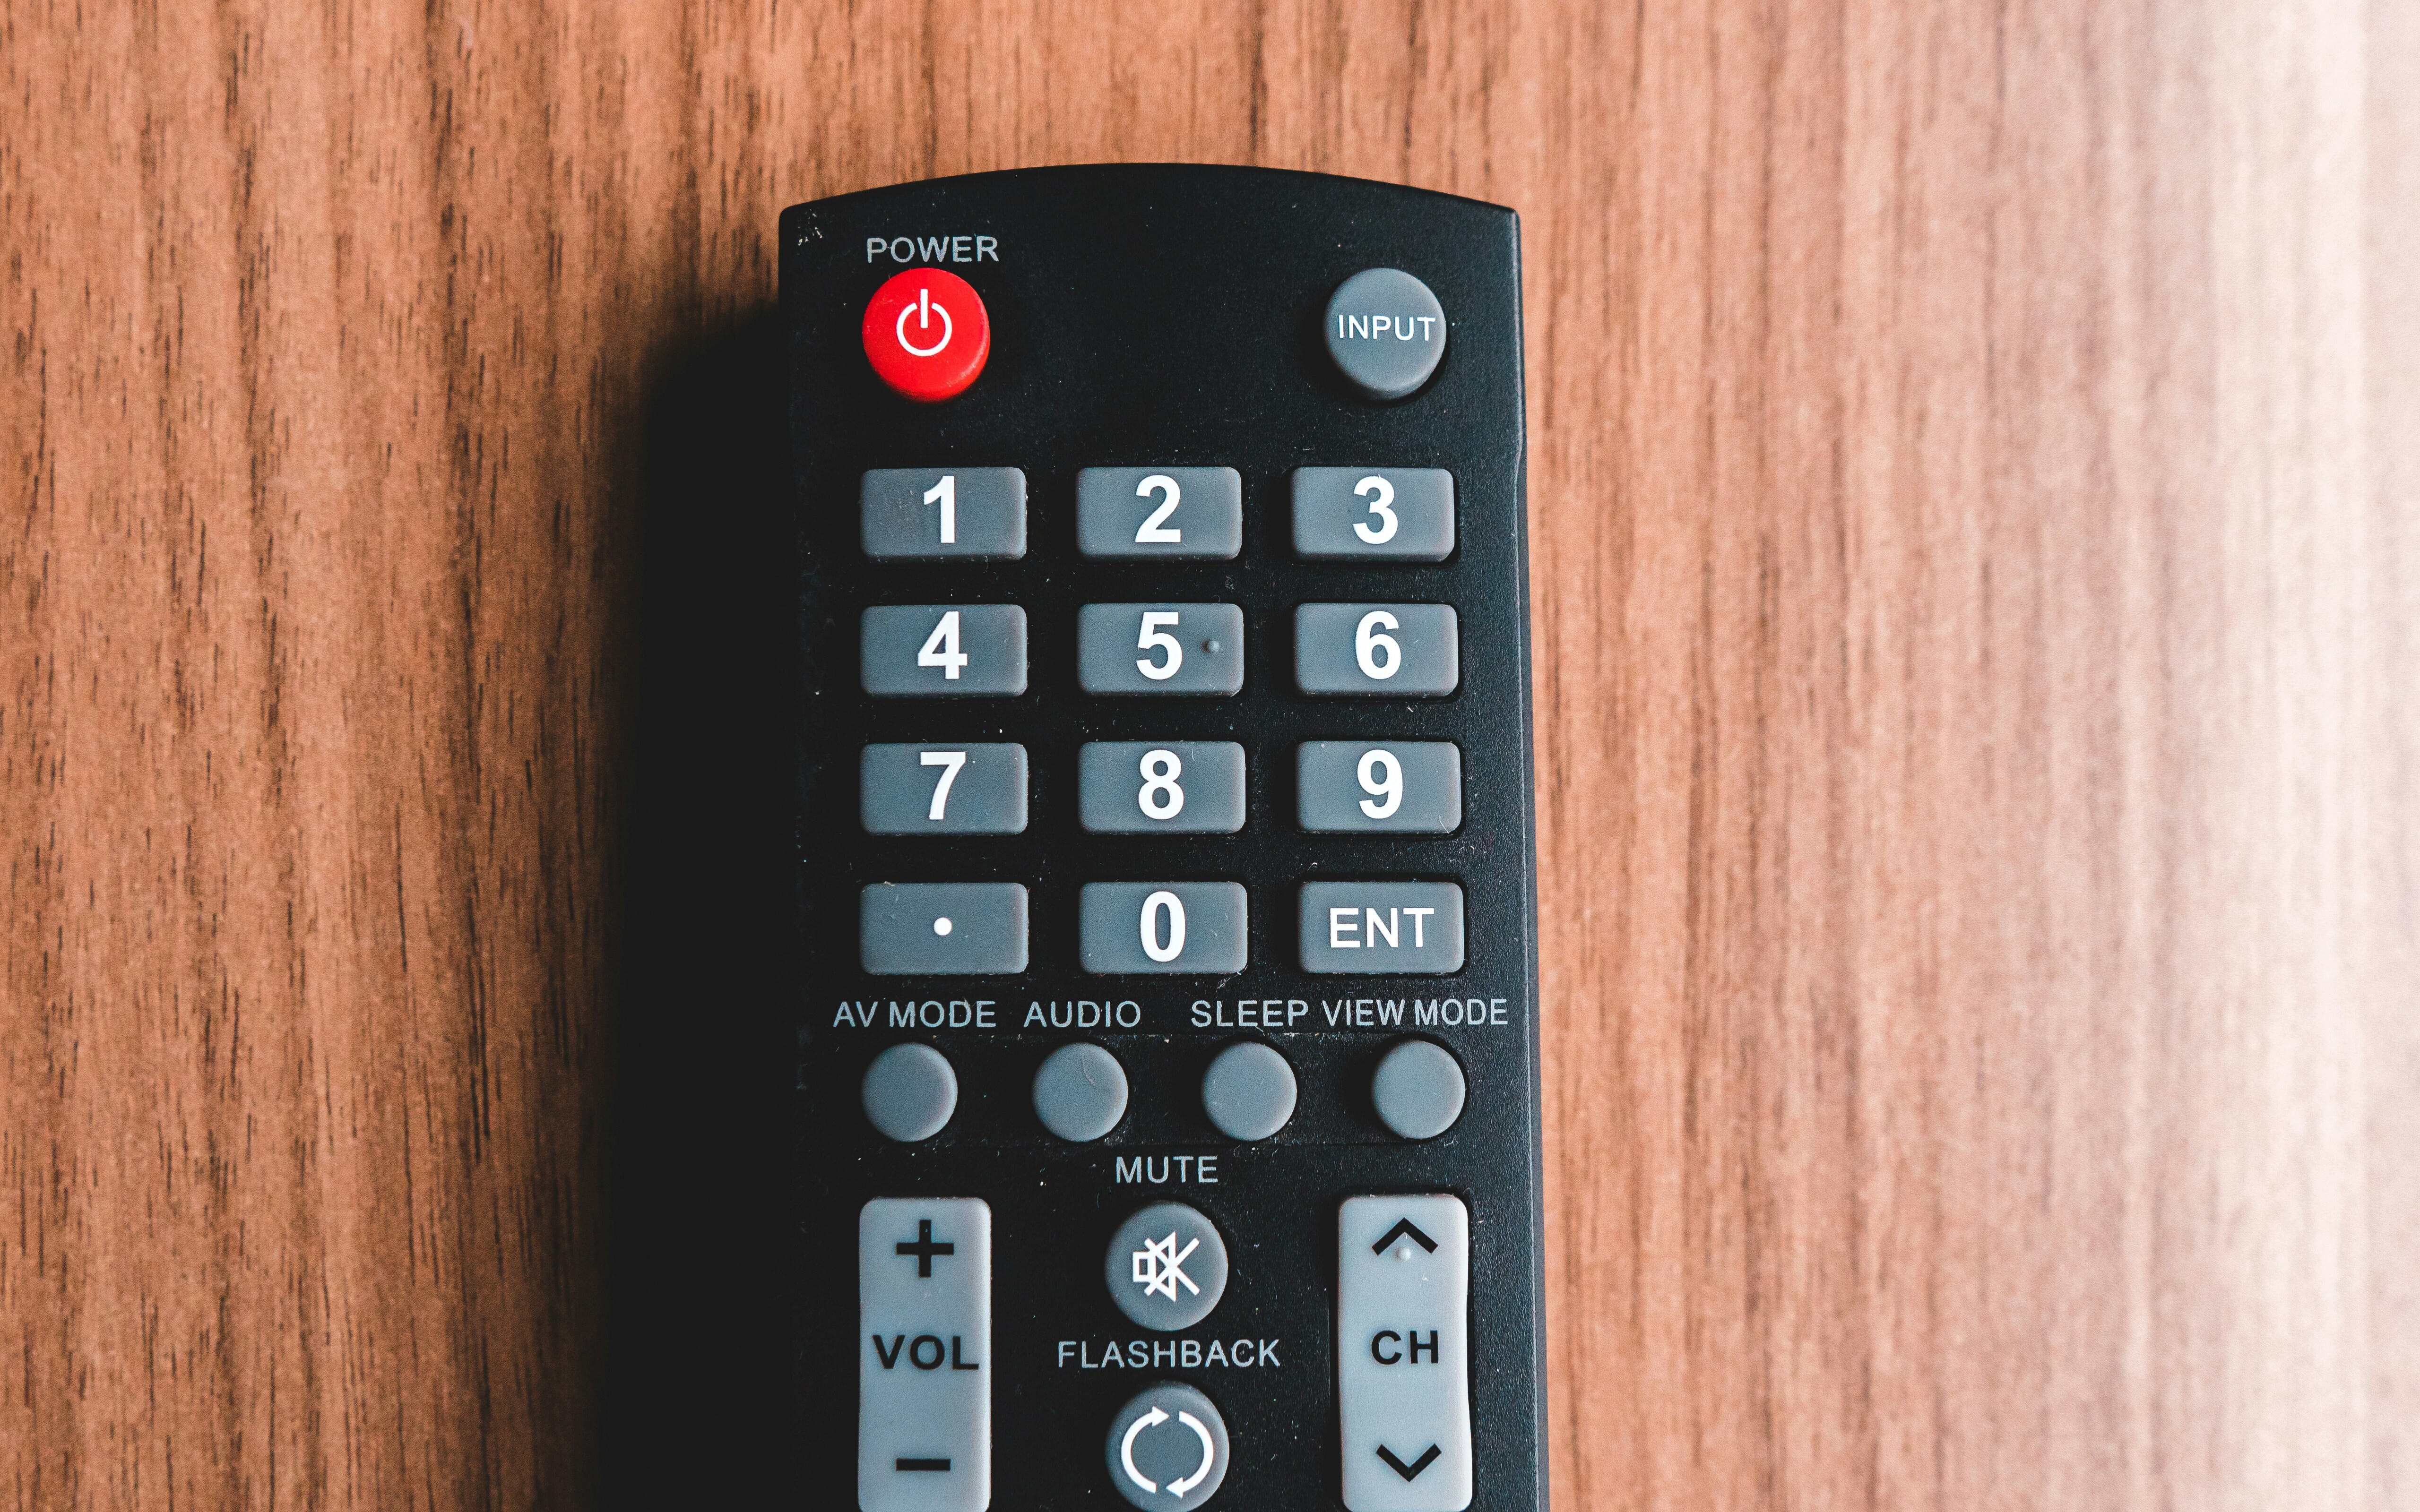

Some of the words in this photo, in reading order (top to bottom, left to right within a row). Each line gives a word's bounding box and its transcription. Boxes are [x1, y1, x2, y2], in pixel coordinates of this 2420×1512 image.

[867, 236, 999, 263] POWER
[1339, 315, 1435, 341] INPUT
[924, 476, 955, 543] 1
[1135, 475, 1180, 542] 2
[1353, 475, 1398, 544] 3
[918, 611, 967, 679] 4
[1137, 612, 1182, 679] 5
[1356, 611, 1401, 679] 6
[921, 752, 966, 819] 7
[1139, 750, 1184, 819] 8
[1357, 750, 1402, 818] 9
[1141, 892, 1185, 962] 0
[1331, 908, 1434, 947] ENT
[833, 1001, 878, 1027] AV
[890, 1000, 996, 1027] MODE
[1024, 1001, 1141, 1027] AUDIO
[1192, 1000, 1308, 1027] SLEEP
[1322, 999, 1405, 1026] VIEW
[1415, 998, 1508, 1025] MODE
[1116, 1156, 1218, 1183] MUTE
[873, 1335, 978, 1370] VOL
[1059, 1339, 1280, 1368] FLASHBACK
[1371, 1331, 1438, 1365] CH
